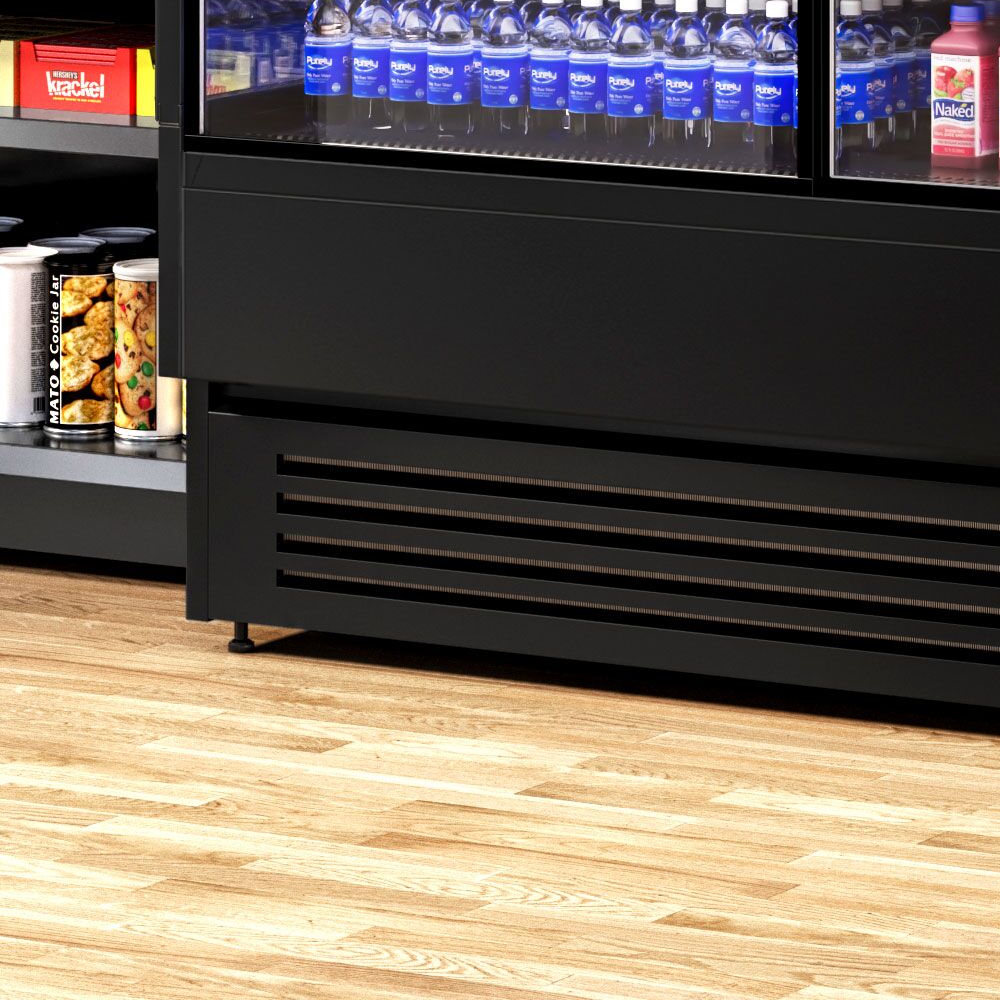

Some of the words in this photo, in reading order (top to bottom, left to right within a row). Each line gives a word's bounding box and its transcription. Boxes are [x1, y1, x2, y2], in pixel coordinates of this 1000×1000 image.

[46, 71, 105, 99] krackel
[52, 71, 78, 80] HERSHEY'S
[935, 101, 975, 118] Naked
[50, 275, 60, 297] Jar
[50, 302, 60, 354] Cookie
[50, 379, 60, 424] MATO
